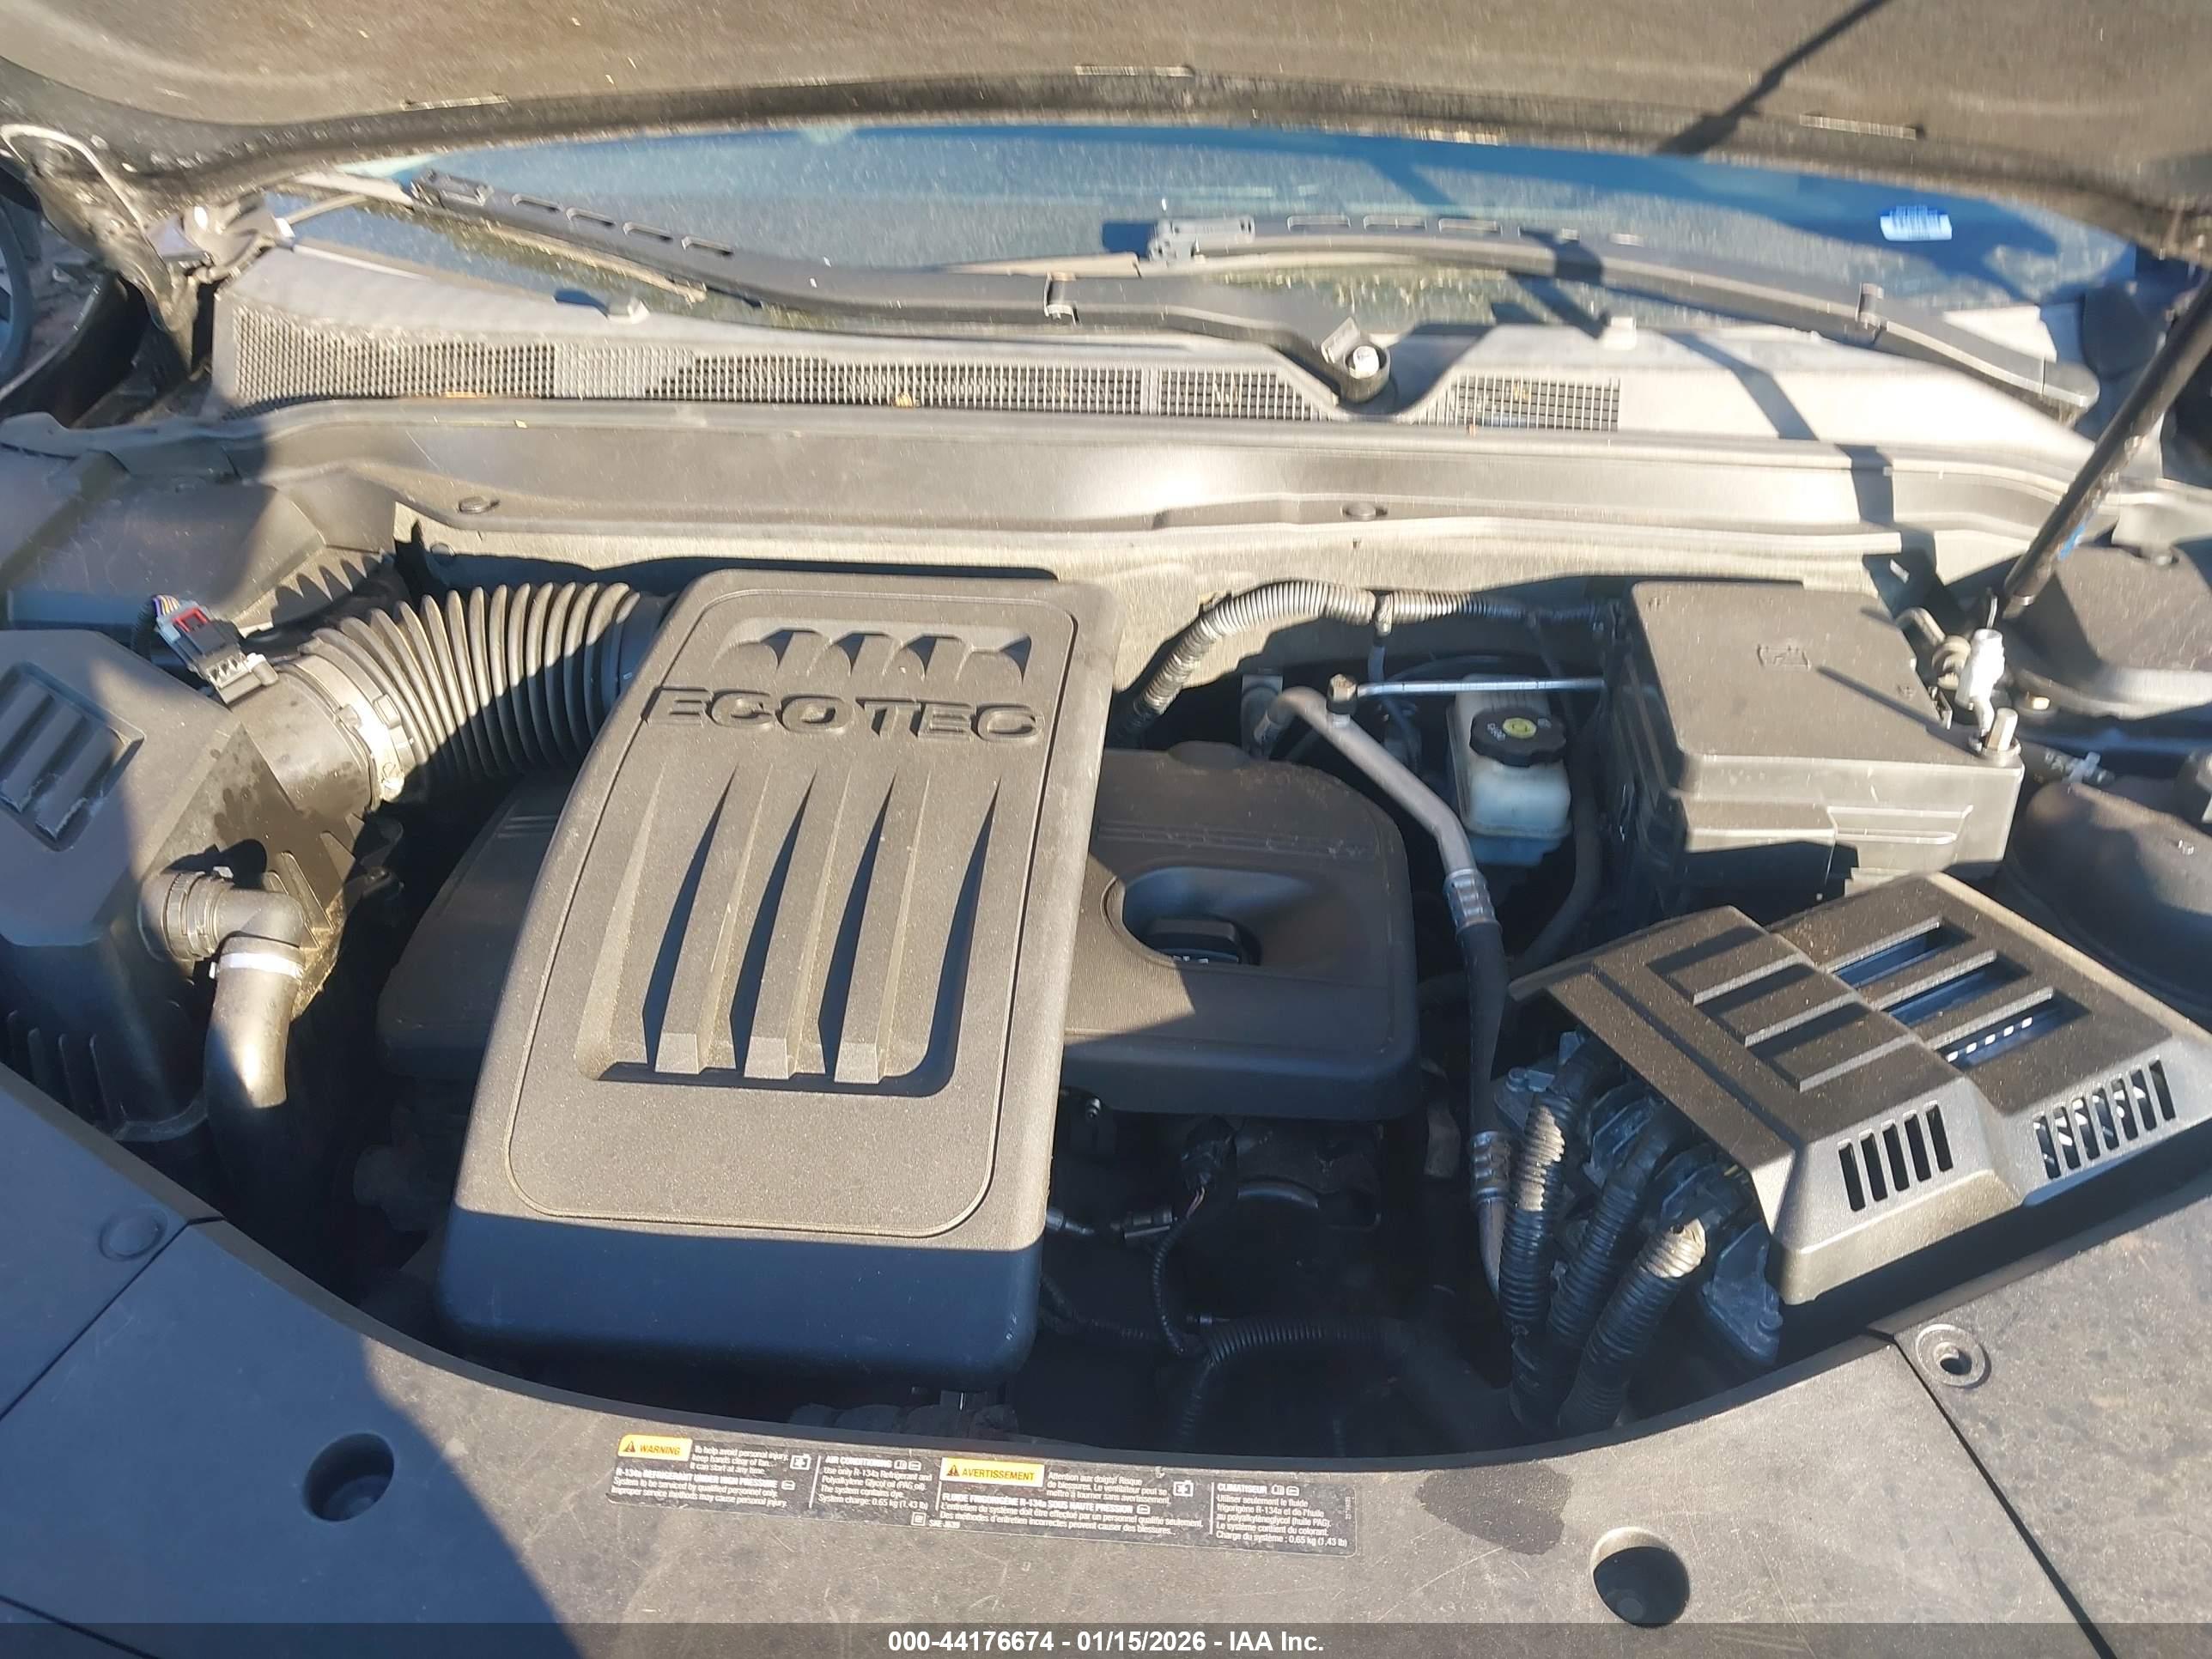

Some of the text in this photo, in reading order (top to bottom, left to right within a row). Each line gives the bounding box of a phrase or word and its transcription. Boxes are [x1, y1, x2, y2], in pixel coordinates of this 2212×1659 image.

[641, 686, 1046, 744] ECOTEC
[640, 1444, 681, 1455] WARNING
[695, 1445, 702, 1454] To
[703, 1446, 718, 1456] help
[720, 1449, 738, 1457] avoid
[738, 1449, 768, 1460] personal
[823, 1467, 836, 1475] Use
[837, 1468, 852, 1477] only
[854, 1468, 878, 1477] R-134a
[879, 1470, 918, 1480] Refrigerant
[962, 1468, 1035, 1481] AVERTISSEMENT
[835, 1486, 859, 1496] system
[860, 1488, 890, 1497] contains
[818, 1494, 844, 1504] System
[845, 1497, 870, 1506] charge:
[890, 1499, 898, 1509] kg
[919, 1502, 928, 1510] lb)
[1217, 1494, 1242, 1504] Utiliser
[1243, 1496, 1279, 1506] seulement
[1288, 1498, 1309, 1508] fluide
[1255, 1505, 1282, 1515] R-134a
[1257, 1524, 1286, 1534] contient
[1287, 1525, 1297, 1534] du
